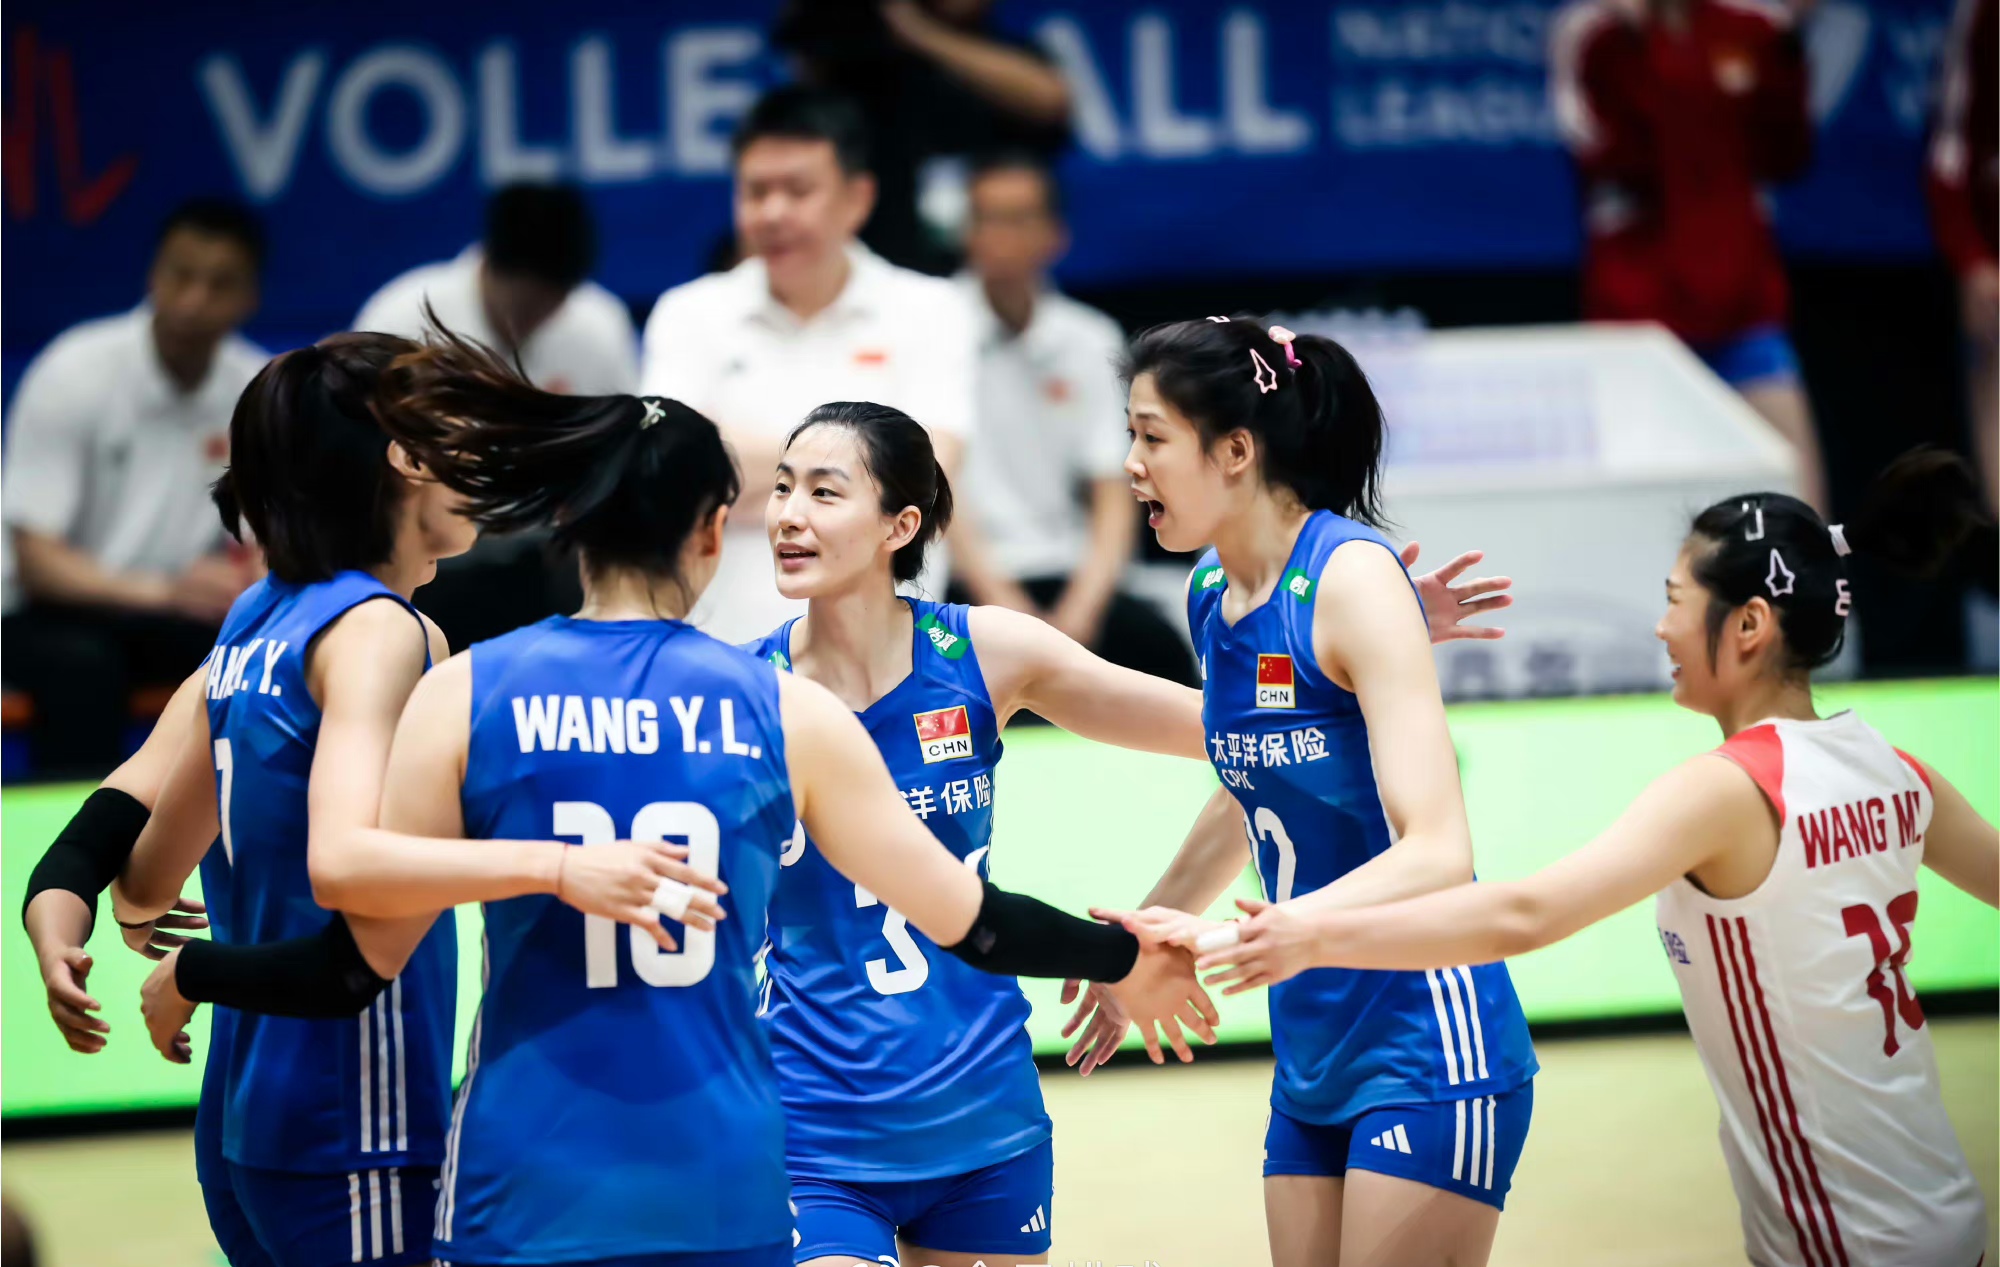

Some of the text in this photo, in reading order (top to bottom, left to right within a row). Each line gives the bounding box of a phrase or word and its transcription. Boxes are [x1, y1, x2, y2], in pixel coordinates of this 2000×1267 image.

[1259, 690, 1289, 704] CHN
[511, 694, 762, 760] WANG Y. L.
[928, 739, 968, 757] CHN
[1210, 726, 1330, 769] 太平洋保险
[1221, 768, 1256, 791] CPIC
[1797, 797, 1888, 869] WANG
[854, 882, 929, 996] 3
